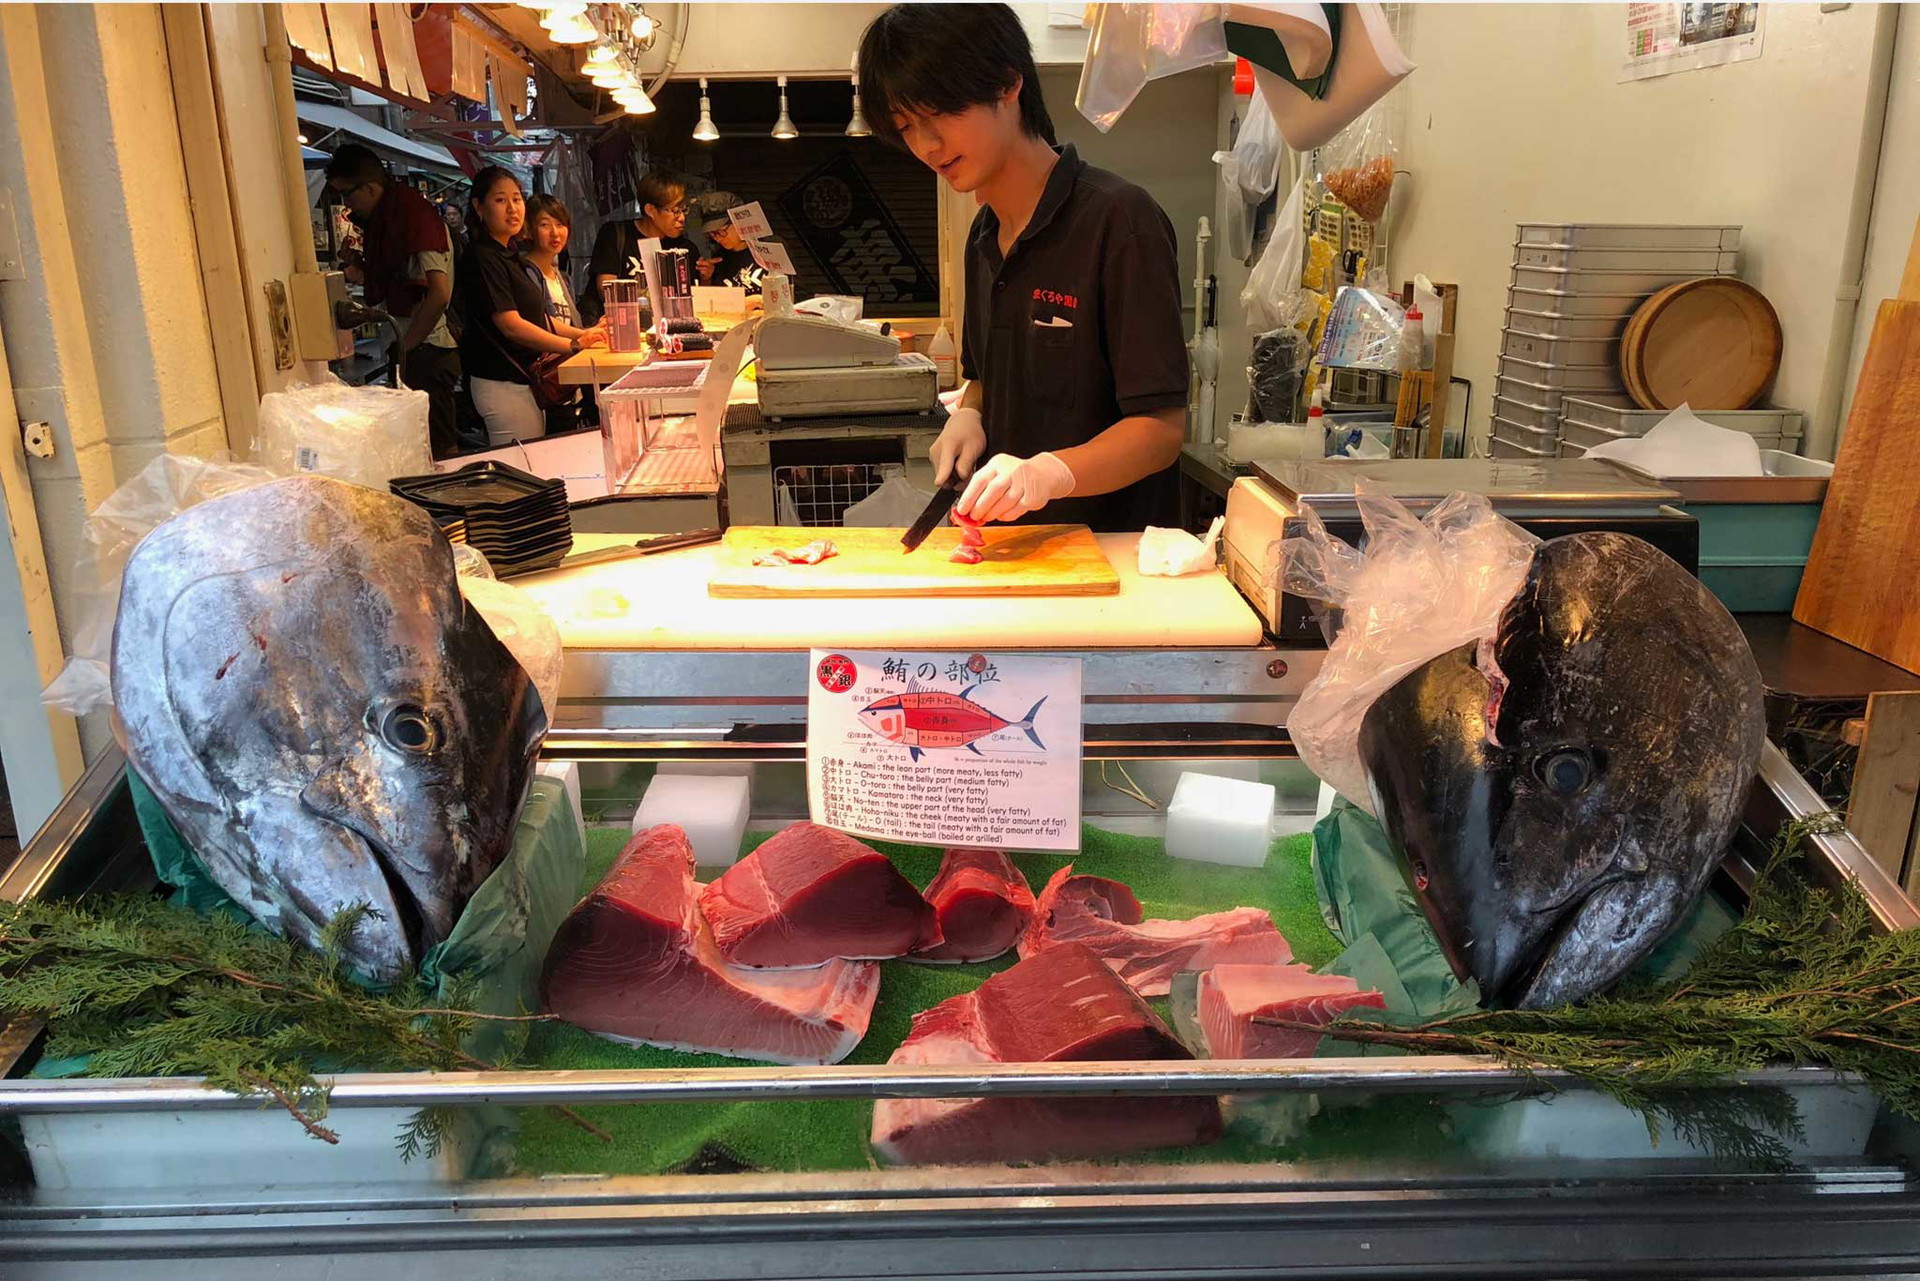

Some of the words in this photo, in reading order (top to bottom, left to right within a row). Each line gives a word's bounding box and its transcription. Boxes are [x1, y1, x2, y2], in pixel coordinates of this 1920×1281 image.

[881, 657, 1001, 685] 鮪の部位
[853, 761, 876, 770] Akami
[933, 767, 954, 776] (more
[957, 768, 982, 777] meaty,
[1001, 769, 1023, 778] fatty)
[860, 770, 894, 780] Chu-toro
[916, 776, 933, 784] belly
[954, 776, 985, 785] (medium
[988, 778, 1009, 787] fatty)
[860, 780, 886, 789] O-toro
[907, 784, 924, 793] belly
[946, 786, 964, 794] (very
[967, 786, 988, 795] fatty)
[854, 797, 879, 806] No-ten
[901, 802, 922, 810] upper
[942, 804, 950, 812] of
[967, 806, 985, 814] head
[987, 807, 1006, 815] (very
[1009, 807, 1031, 816] fatty)
[868, 790, 904, 800] Kamatoro
[925, 794, 942, 802] neck
[945, 795, 964, 803] (very
[966, 796, 988, 805] fatty)
[861, 807, 898, 818] Hoho-niku
[906, 811, 918, 819] the
[920, 812, 941, 820] cheek
[944, 814, 970, 823] (meaty
[972, 815, 987, 823] with
[997, 816, 1010, 824] fair
[1042, 818, 1050, 826] of
[1052, 818, 1066, 827] fat)
[855, 823, 885, 833] Medama
[892, 828, 903, 836] the
[906, 830, 936, 839] eye-ball
[939, 831, 964, 840] (boiled
[976, 835, 1002, 843] grilled)
[884, 818, 902, 826] (tail)
[909, 820, 921, 828] the
[923, 822, 935, 830] tail
[938, 823, 963, 832] (meaty
[966, 824, 981, 832] with
[1035, 827, 1043, 835] of
[1046, 828, 1060, 837] fat)
